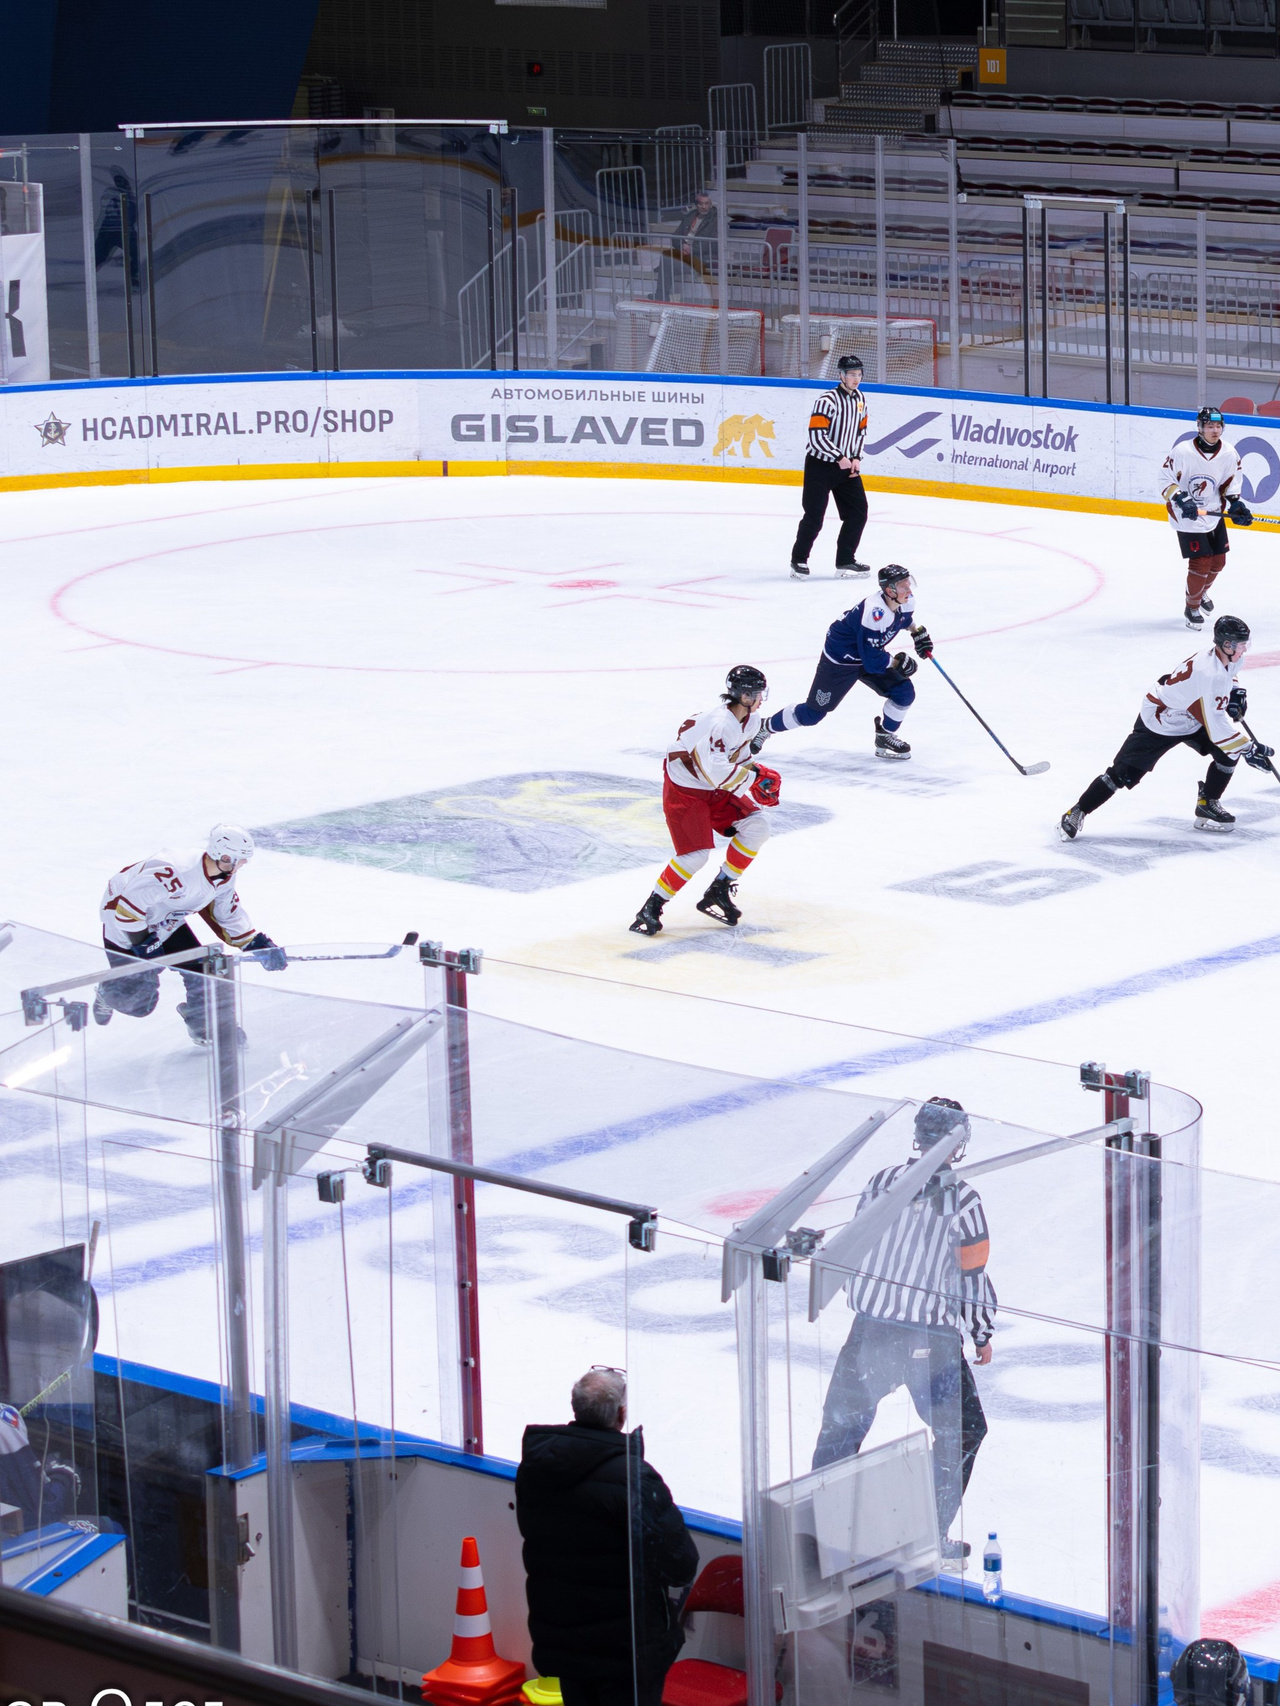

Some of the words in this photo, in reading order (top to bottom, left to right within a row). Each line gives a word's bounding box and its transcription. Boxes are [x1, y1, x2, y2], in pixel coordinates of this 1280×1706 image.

[986, 59, 1000, 73] 101
[490, 387, 646, 403] АВТОМОБИЛЬНЫЕ
[651, 391, 704, 404] ШИНЫ
[82, 407, 394, 441] HCADMIRAL.PRO/SHOP
[450, 413, 705, 447] GISLAVED
[950, 413, 1079, 453] Vladivostok
[951, 450, 1028, 472] International
[1032, 458, 1077, 478] Airport
[153, 867, 184, 894] 25
